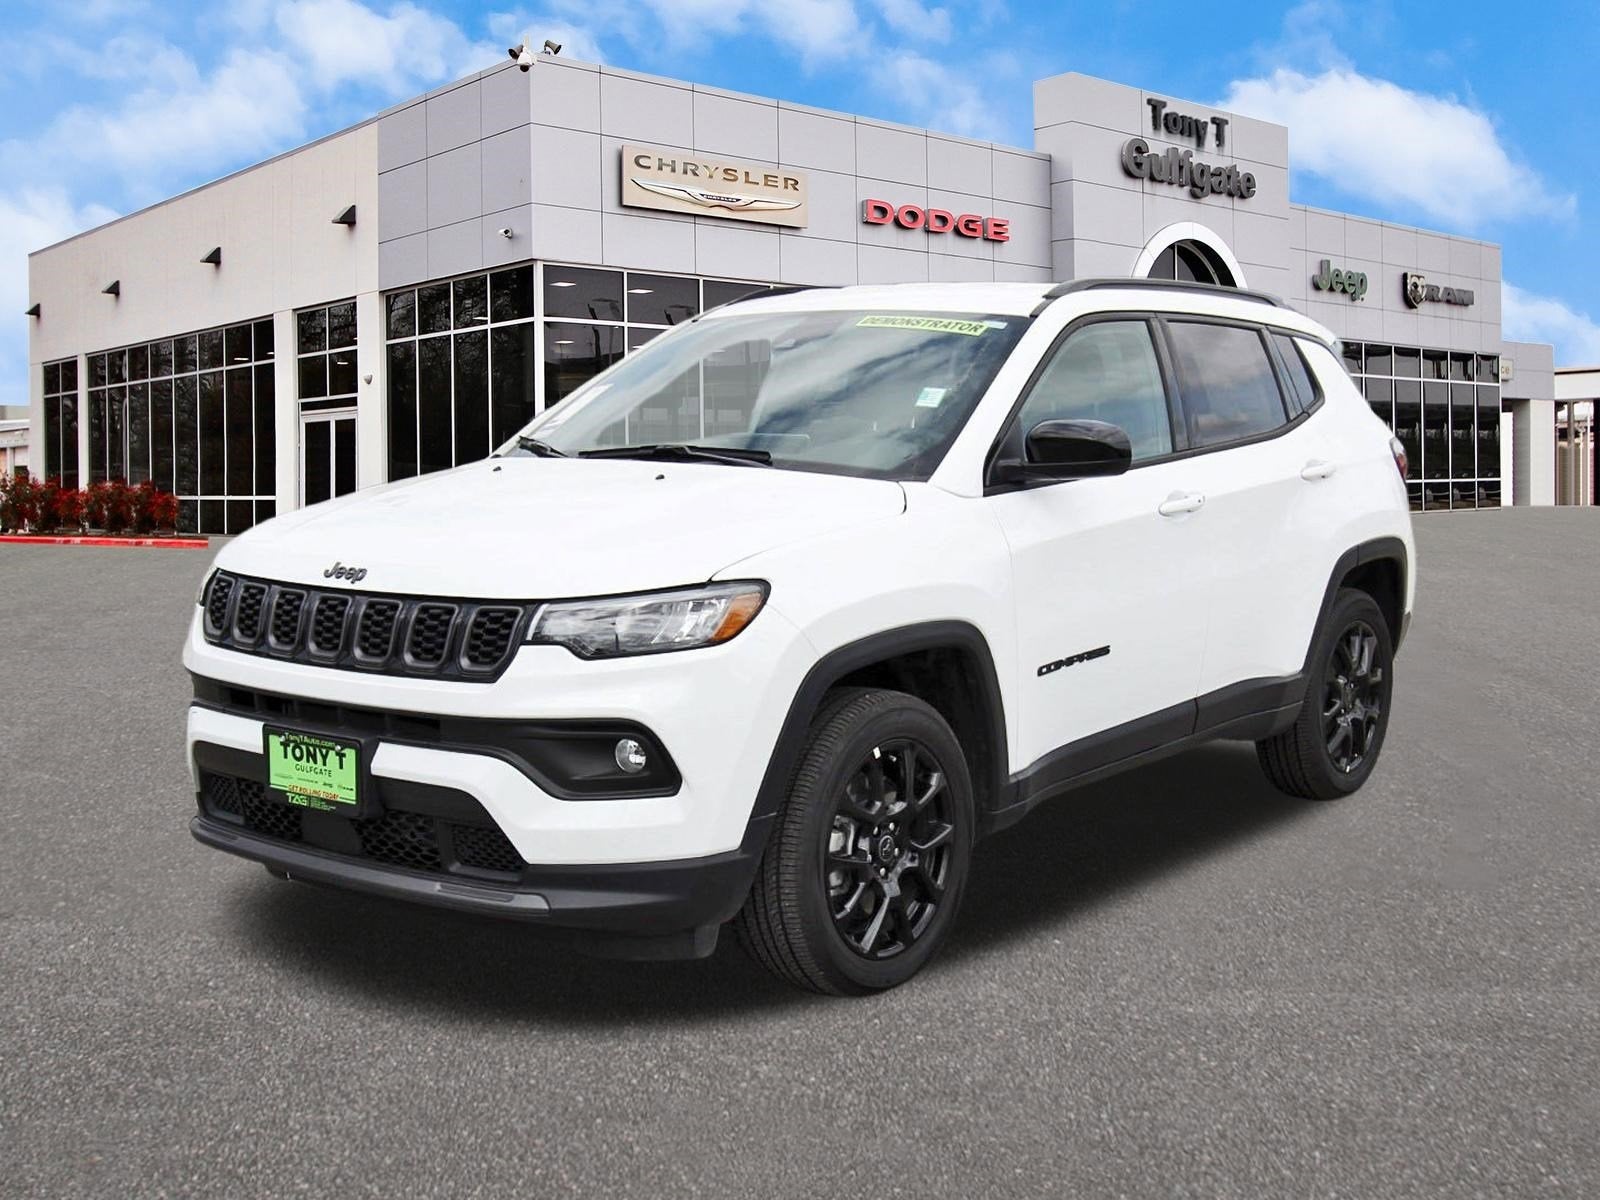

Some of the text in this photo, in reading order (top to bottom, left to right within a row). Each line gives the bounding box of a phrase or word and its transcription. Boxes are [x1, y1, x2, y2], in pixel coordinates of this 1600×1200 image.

[1146, 98, 1229, 148] Tony T
[633, 154, 801, 192] CHRYSLER
[1120, 138, 1257, 200] Gulfgate
[862, 199, 1010, 243] DODGE
[1313, 259, 1368, 301] Jeep
[1424, 284, 1475, 307] RAM
[860, 317, 983, 332] DEMONSTRATOR
[323, 561, 368, 584] Jeep
[1037, 645, 1110, 676] COMPASS
[280, 741, 346, 769] TONY T
[295, 763, 332, 778] GULFGATE
